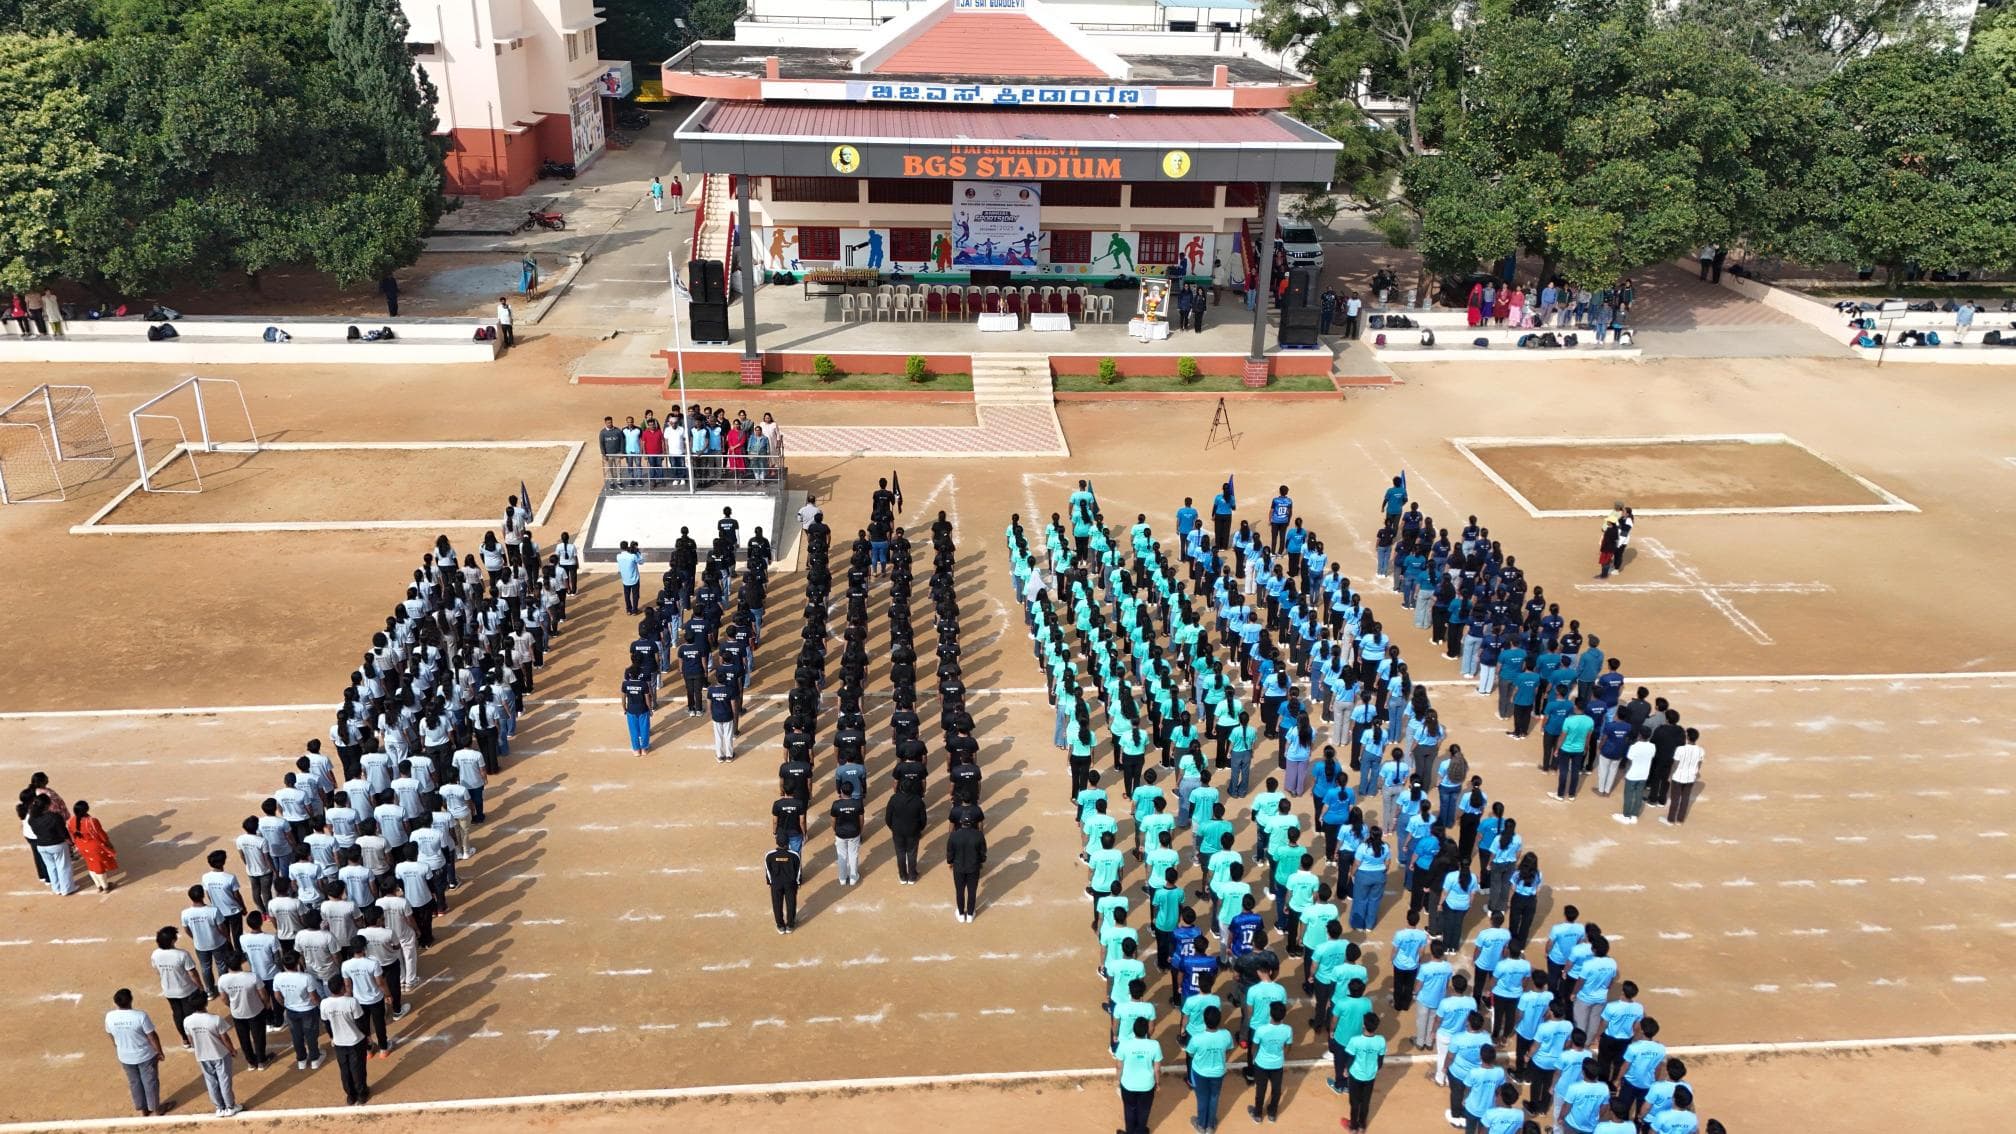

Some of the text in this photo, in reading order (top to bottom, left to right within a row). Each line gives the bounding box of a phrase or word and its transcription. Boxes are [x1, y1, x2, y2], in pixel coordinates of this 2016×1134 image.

[984, 146, 1004, 154] SRI
[1008, 147, 1065, 155] GURUDEV
[903, 155, 1122, 178] BGS STADIUM
[1243, 930, 1253, 944] 17
[1181, 943, 1195, 956] 45
